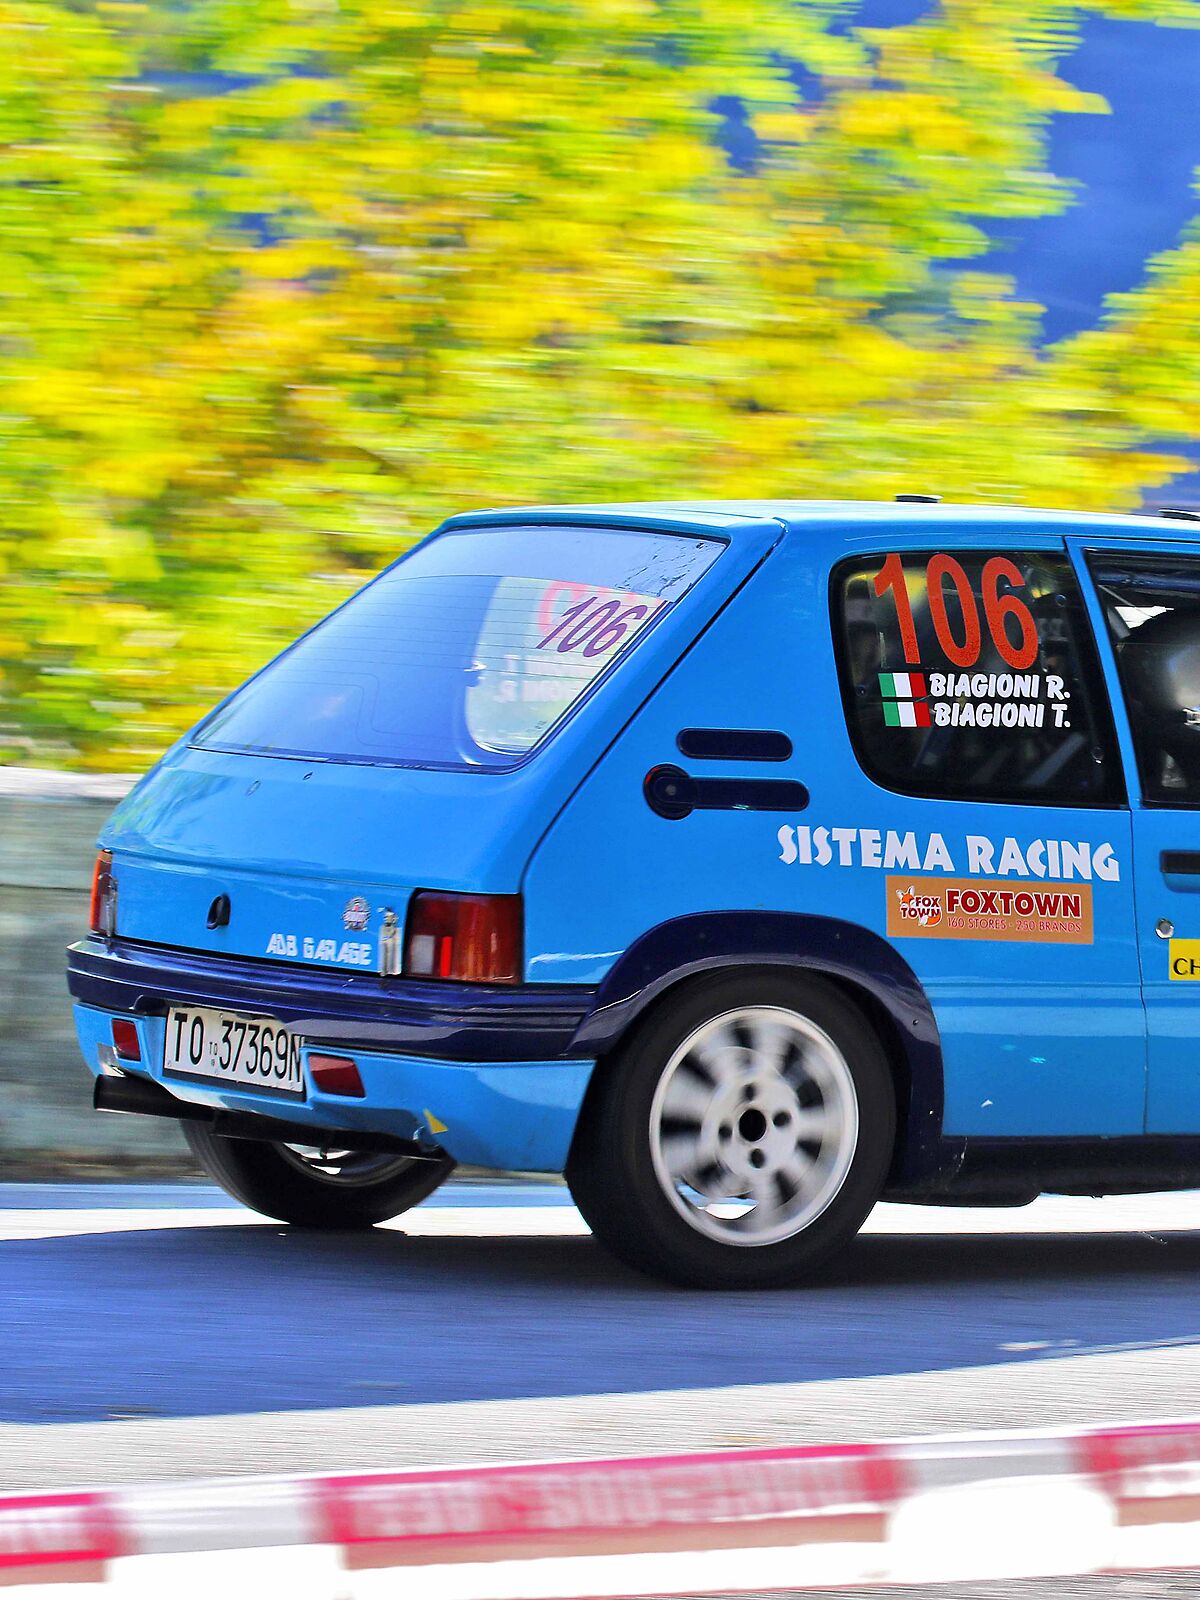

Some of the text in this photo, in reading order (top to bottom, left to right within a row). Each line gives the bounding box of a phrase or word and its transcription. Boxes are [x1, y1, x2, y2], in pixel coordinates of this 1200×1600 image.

[872, 553, 1038, 669] 106
[536, 597, 648, 657] 106
[929, 673, 1071, 700] BIAGIONI R.
[933, 703, 1071, 728] BIAGIONI T.
[777, 824, 1120, 882] SISTEMA RACING
[901, 907, 940, 919] TOWN
[915, 896, 940, 908] FOX
[946, 889, 1082, 919] FOXTOWN
[946, 917, 1082, 933] 160 STORES 250 BRANDS
[303, 937, 372, 966] GARAGE
[174, 1012, 303, 1083] TO 37369N
